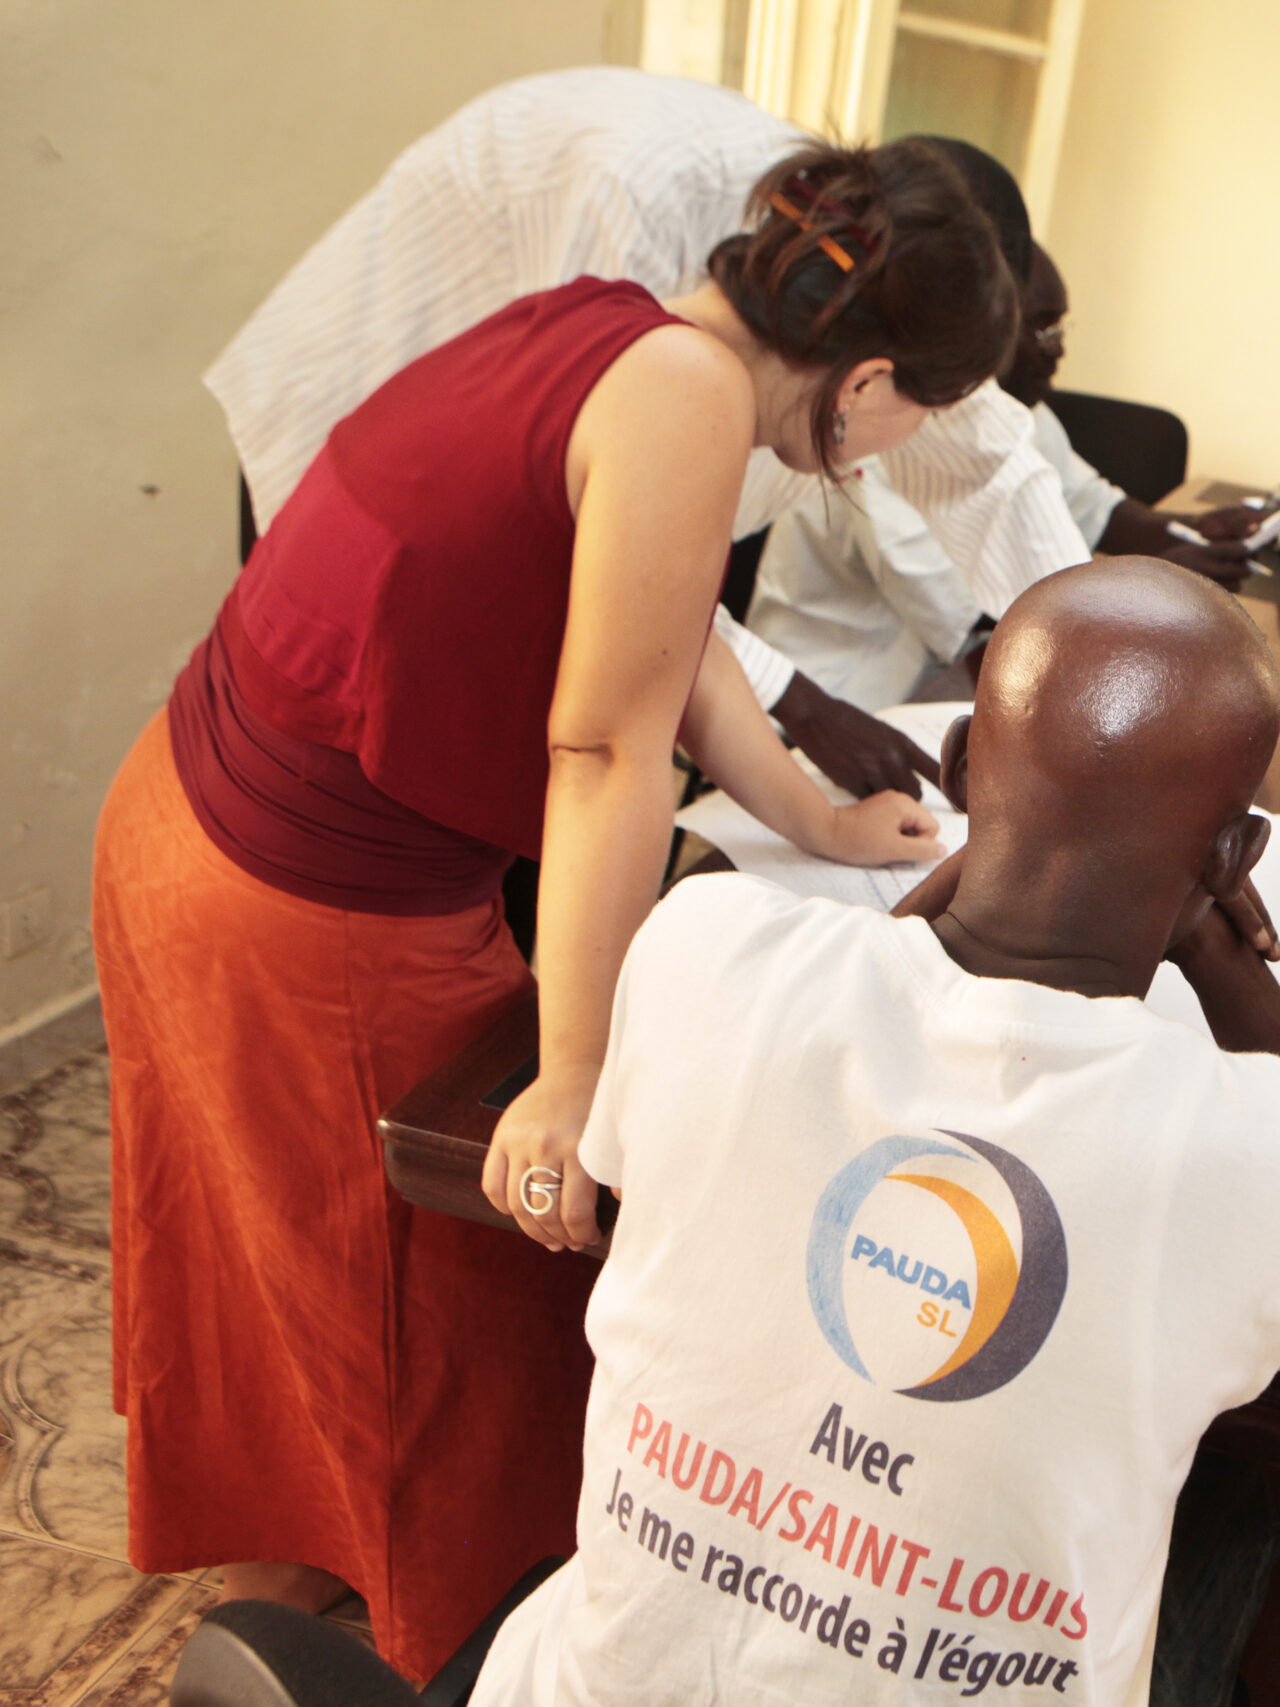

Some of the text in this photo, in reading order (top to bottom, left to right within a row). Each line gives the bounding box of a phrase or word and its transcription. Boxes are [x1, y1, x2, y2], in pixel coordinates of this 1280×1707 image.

[851, 1234, 972, 1310] PAUDA
[916, 1301, 957, 1338] SL
[809, 1402, 915, 1496] Avec
[626, 1402, 1088, 1641] PAUDA/SAINT-LOUIS
[606, 1468, 1079, 1696] Je me raccorde à l'égout
